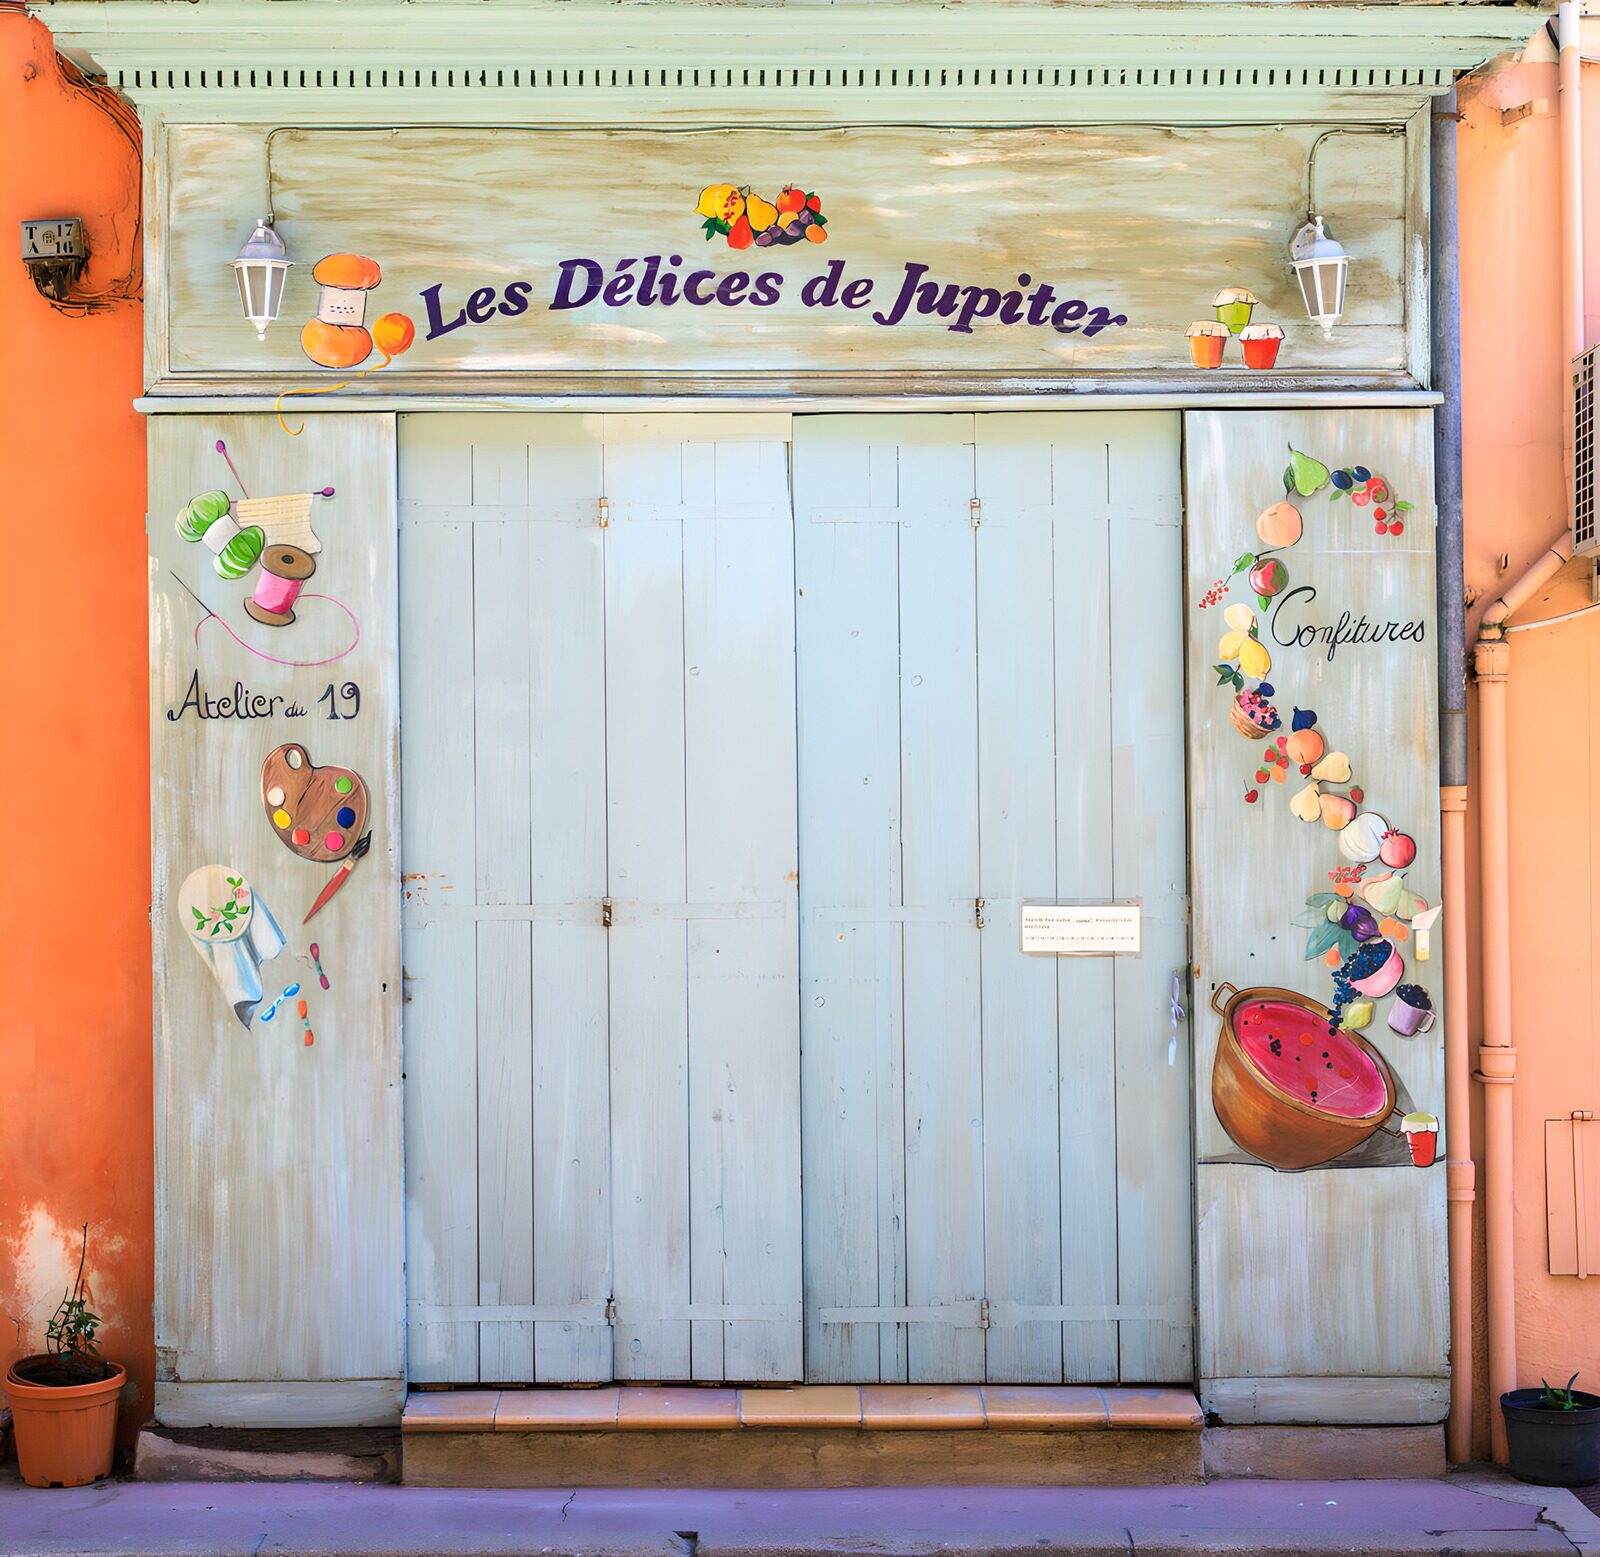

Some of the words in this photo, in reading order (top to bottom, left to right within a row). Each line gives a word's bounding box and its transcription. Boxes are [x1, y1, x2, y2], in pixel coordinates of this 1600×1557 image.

[25, 226, 38, 240] T
[57, 223, 74, 237] 17
[419, 281, 533, 341] Les
[548, 254, 784, 310] Délices
[801, 259, 875, 309] de
[872, 261, 1129, 338] Jupiter
[1271, 585, 1425, 662] Confitures
[167, 668, 285, 721] Atelier
[284, 701, 308, 719] du
[317, 681, 361, 720] 19
